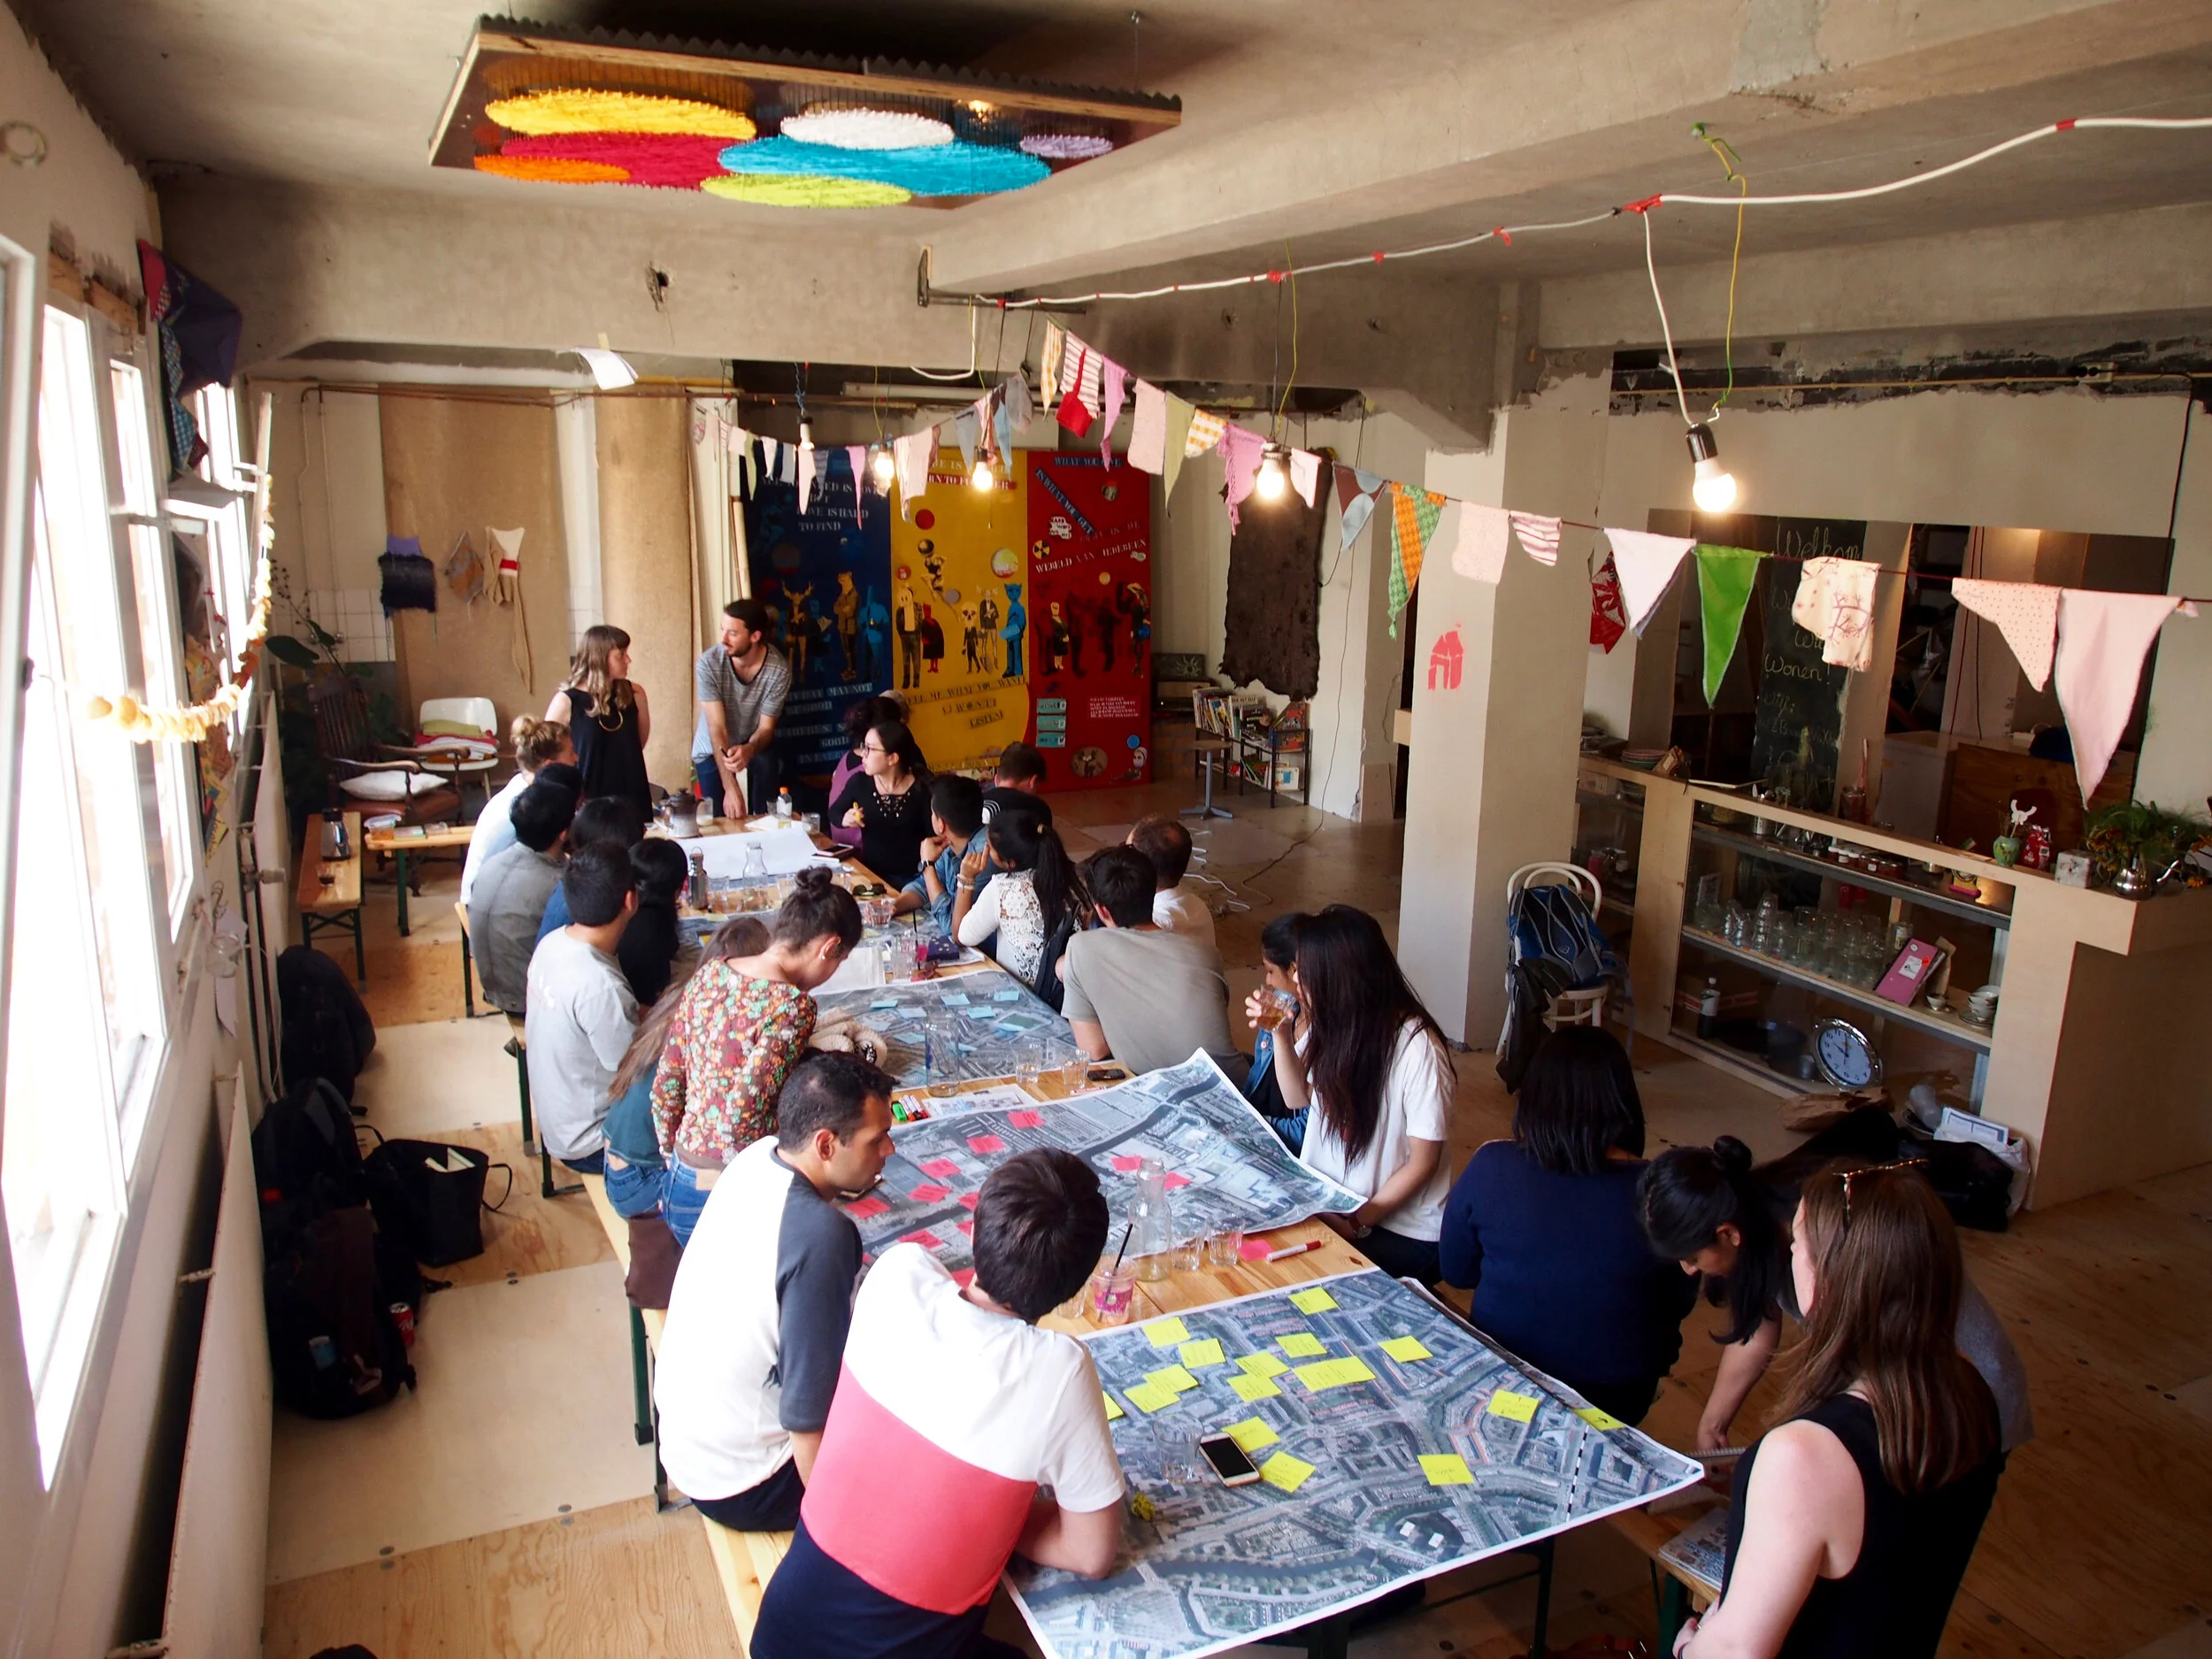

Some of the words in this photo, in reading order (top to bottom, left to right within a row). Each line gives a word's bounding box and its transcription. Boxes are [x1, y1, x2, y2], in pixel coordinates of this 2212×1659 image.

[1055, 457, 1079, 466] WHAT
[843, 483, 853, 493] IS
[827, 508, 838, 518] IS
[798, 521, 814, 533] TO
[816, 521, 841, 532] FIND
[1776, 525, 1859, 559] Welkom
[1035, 557, 1073, 573] WERELD
